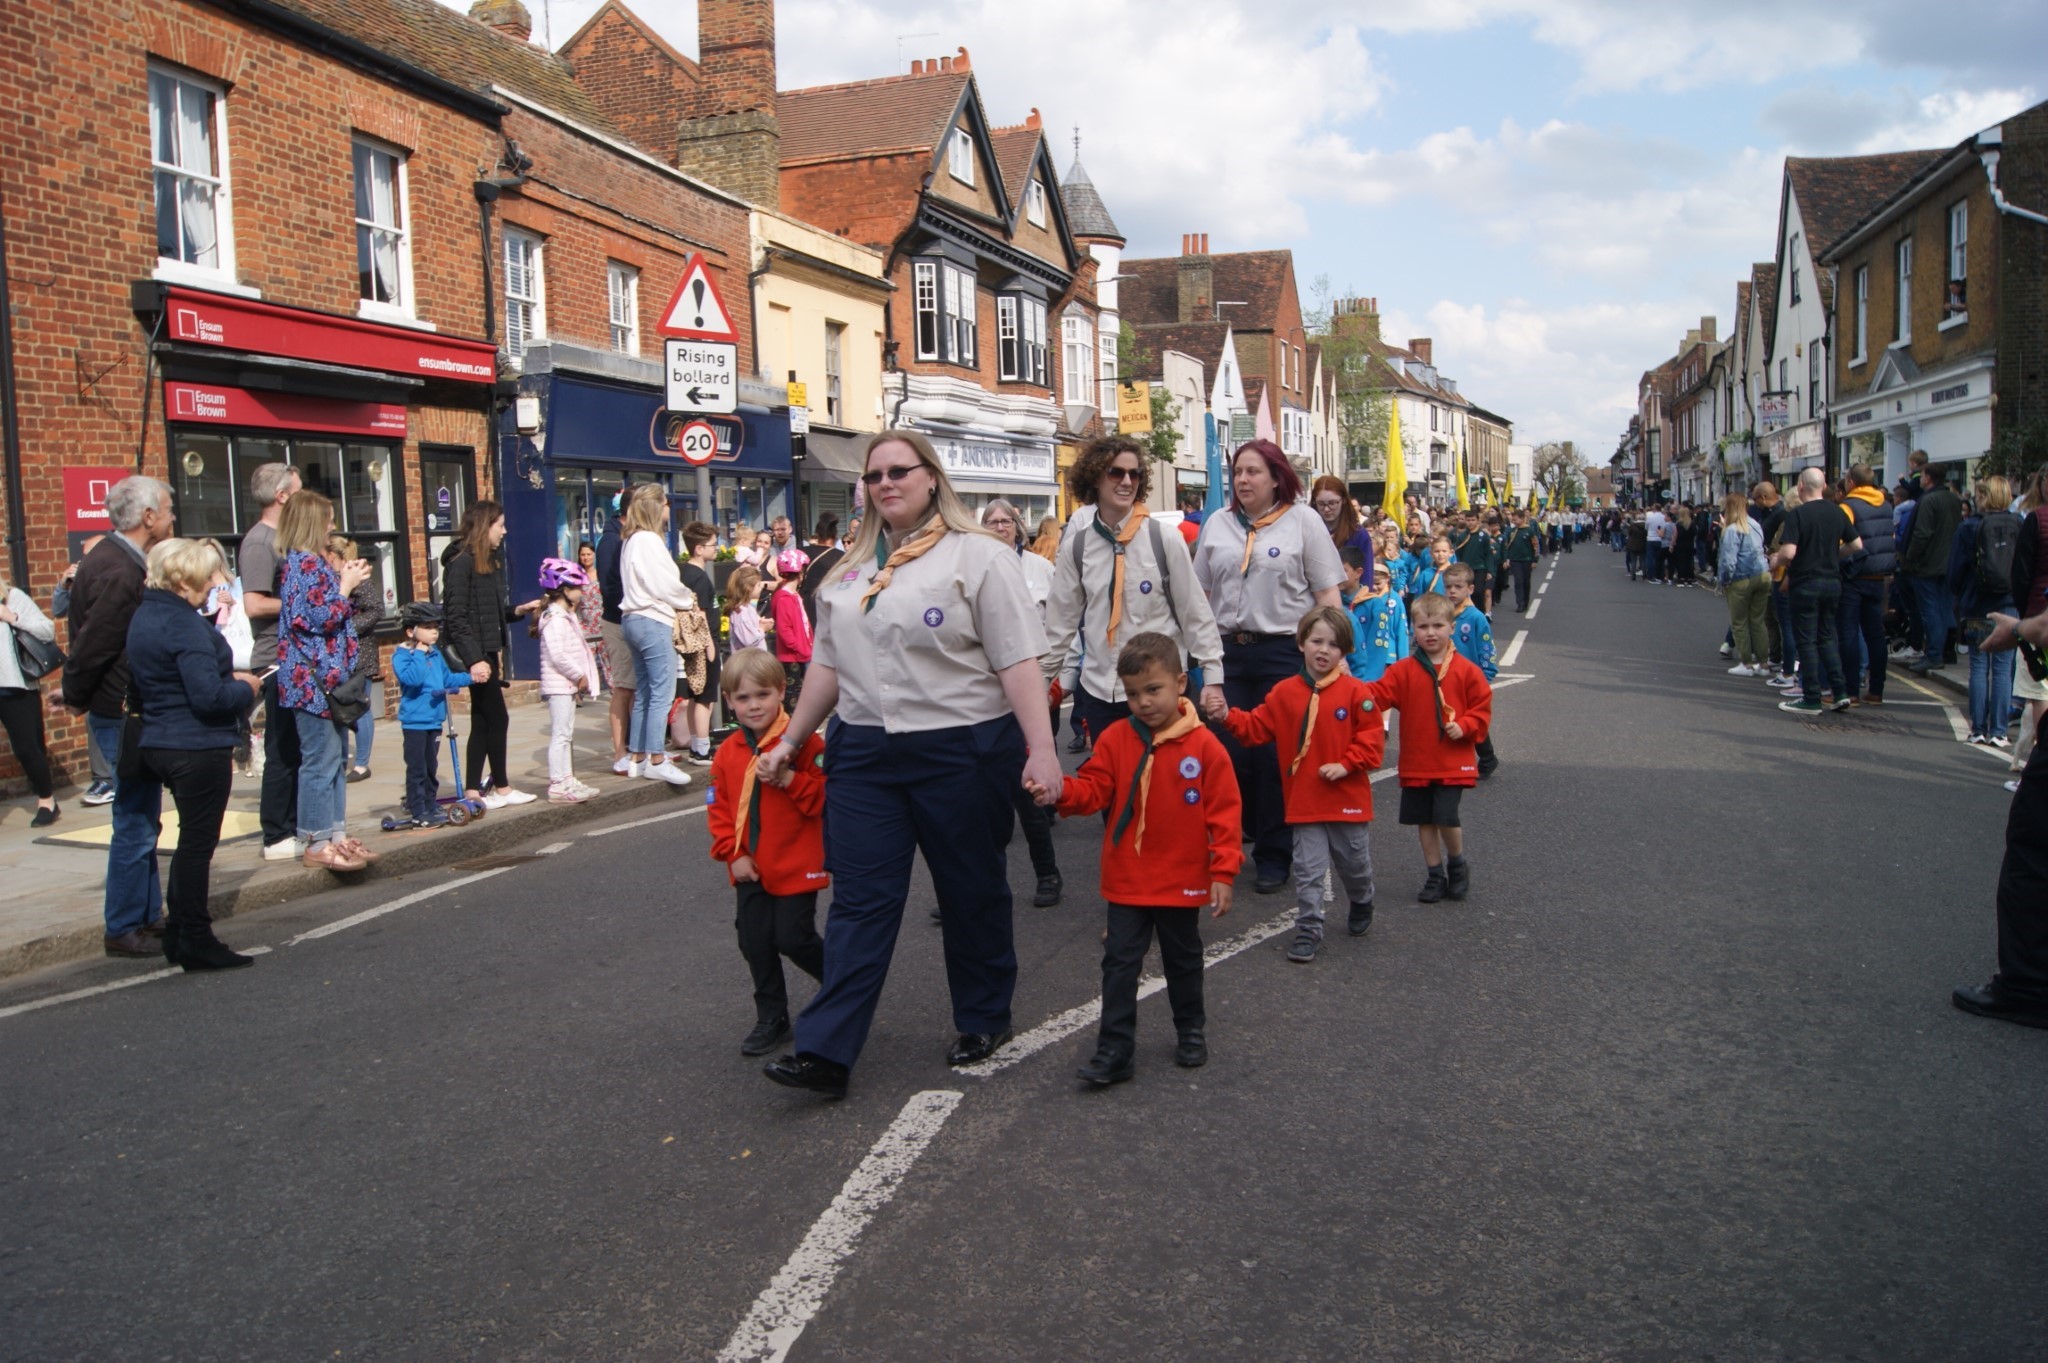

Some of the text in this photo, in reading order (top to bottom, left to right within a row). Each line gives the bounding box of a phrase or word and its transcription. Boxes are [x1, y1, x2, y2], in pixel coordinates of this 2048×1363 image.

[199, 319, 223, 333] Ensum
[200, 330, 224, 343] Brown
[677, 348, 725, 367] Rising
[418, 356, 492, 377] ensumbrown.com
[673, 368, 730, 385] bollard
[195, 390, 226, 405] Ensum
[196, 404, 227, 418] Brown
[1121, 413, 1148, 423] MEXICAN
[685, 433, 712, 452] 20
[961, 444, 1009, 469] ANDREWS
